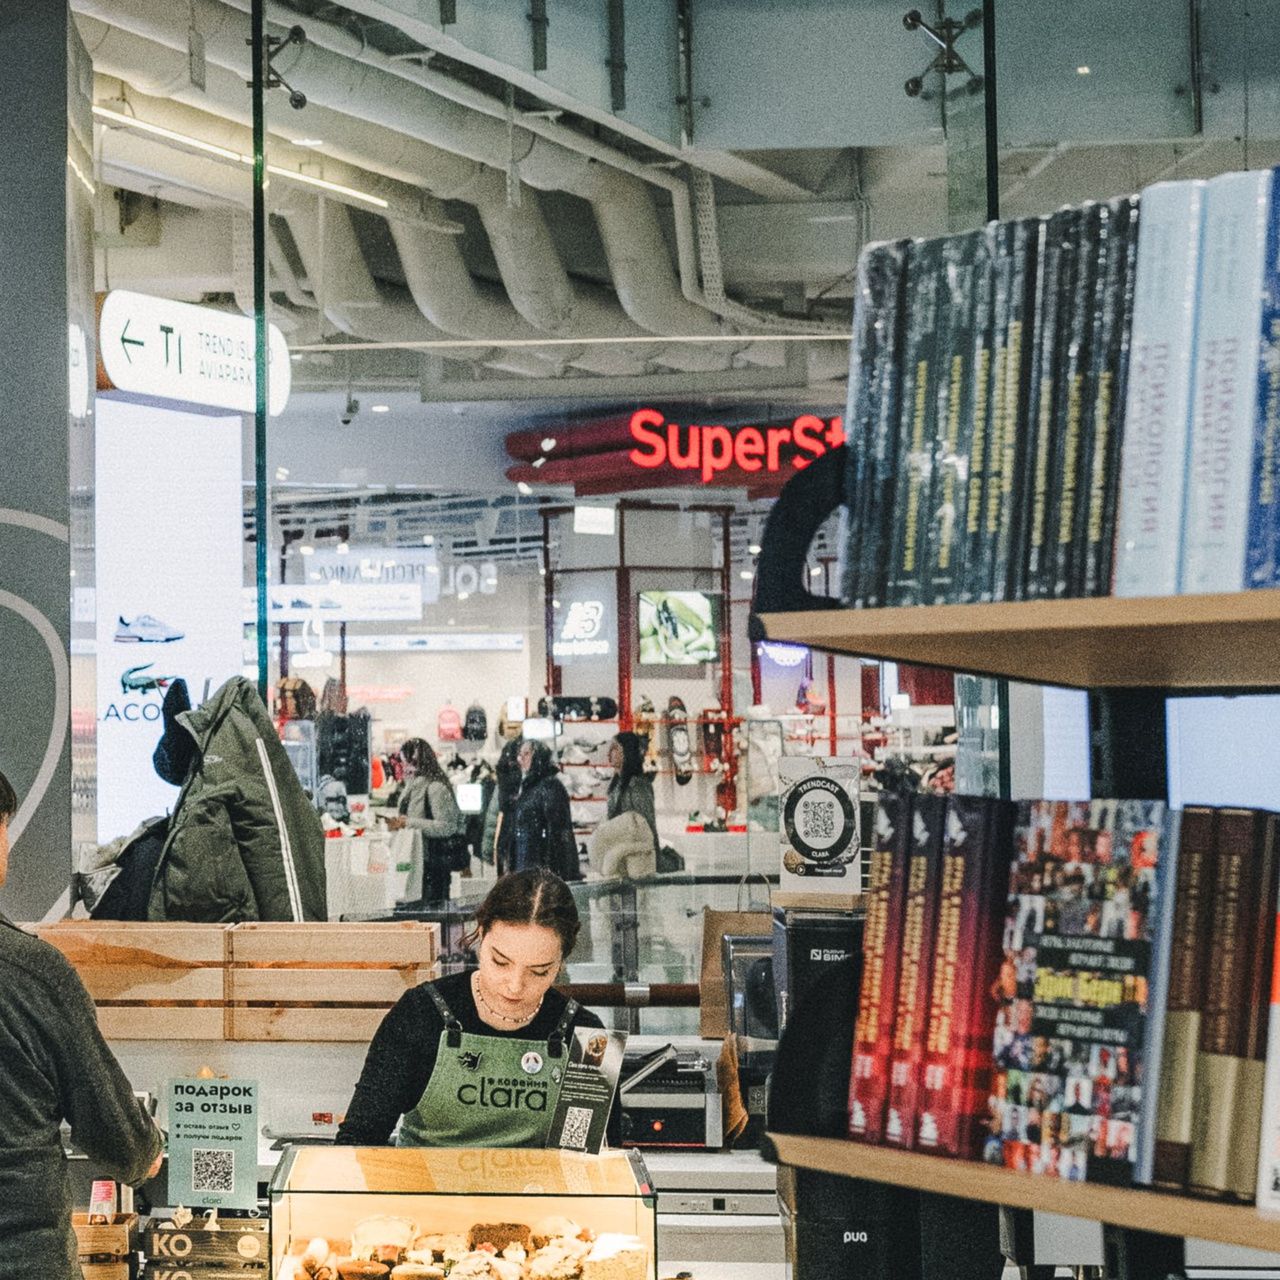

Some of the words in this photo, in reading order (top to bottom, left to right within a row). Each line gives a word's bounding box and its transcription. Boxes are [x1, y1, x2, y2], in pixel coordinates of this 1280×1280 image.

[798, 780, 839, 794] TRENDCAST
[497, 1077, 549, 1089] кофейня
[174, 1084, 253, 1100] подарок
[457, 1076, 549, 1112] clara
[174, 1102, 195, 1113] за
[200, 1102, 253, 1114] отзыв
